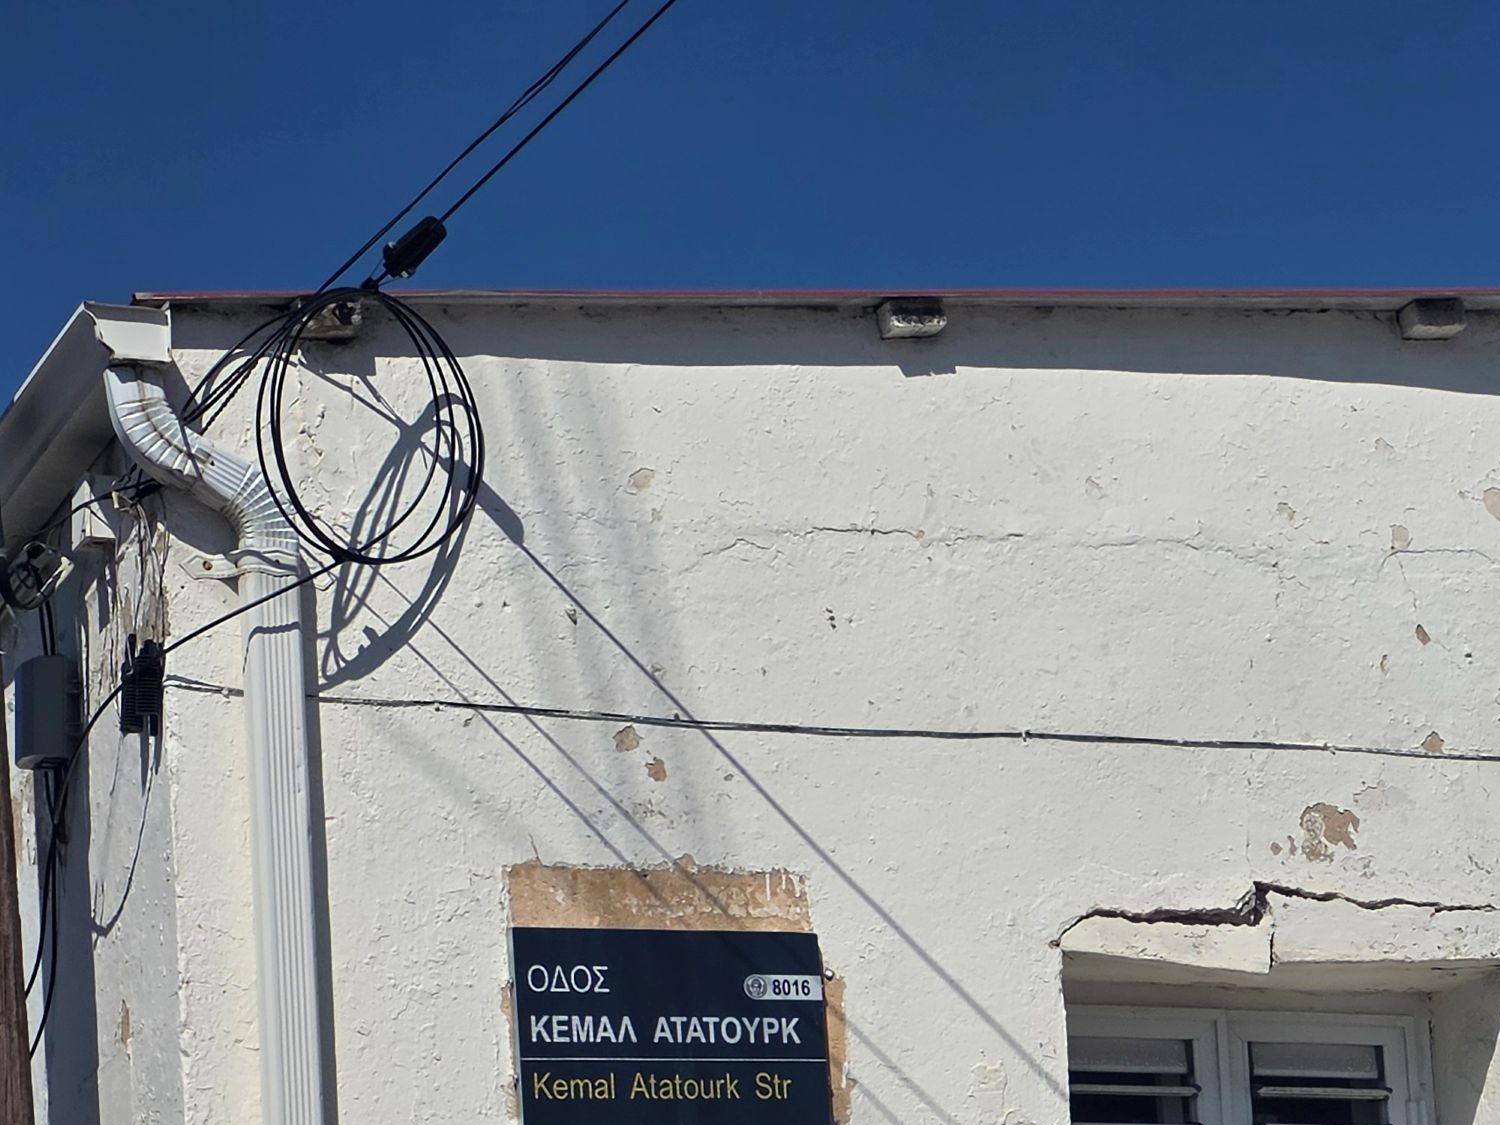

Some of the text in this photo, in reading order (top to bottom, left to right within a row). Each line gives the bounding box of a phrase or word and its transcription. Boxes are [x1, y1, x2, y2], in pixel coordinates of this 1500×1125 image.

[527, 964, 611, 993] ΟΔΟΣ
[772, 978, 811, 996] 8016
[530, 1015, 802, 1044] ΚΕΜΑΛ ΑΤΑΤΟΥΡΚ
[533, 1072, 793, 1100] Kemal Atatourk Str
